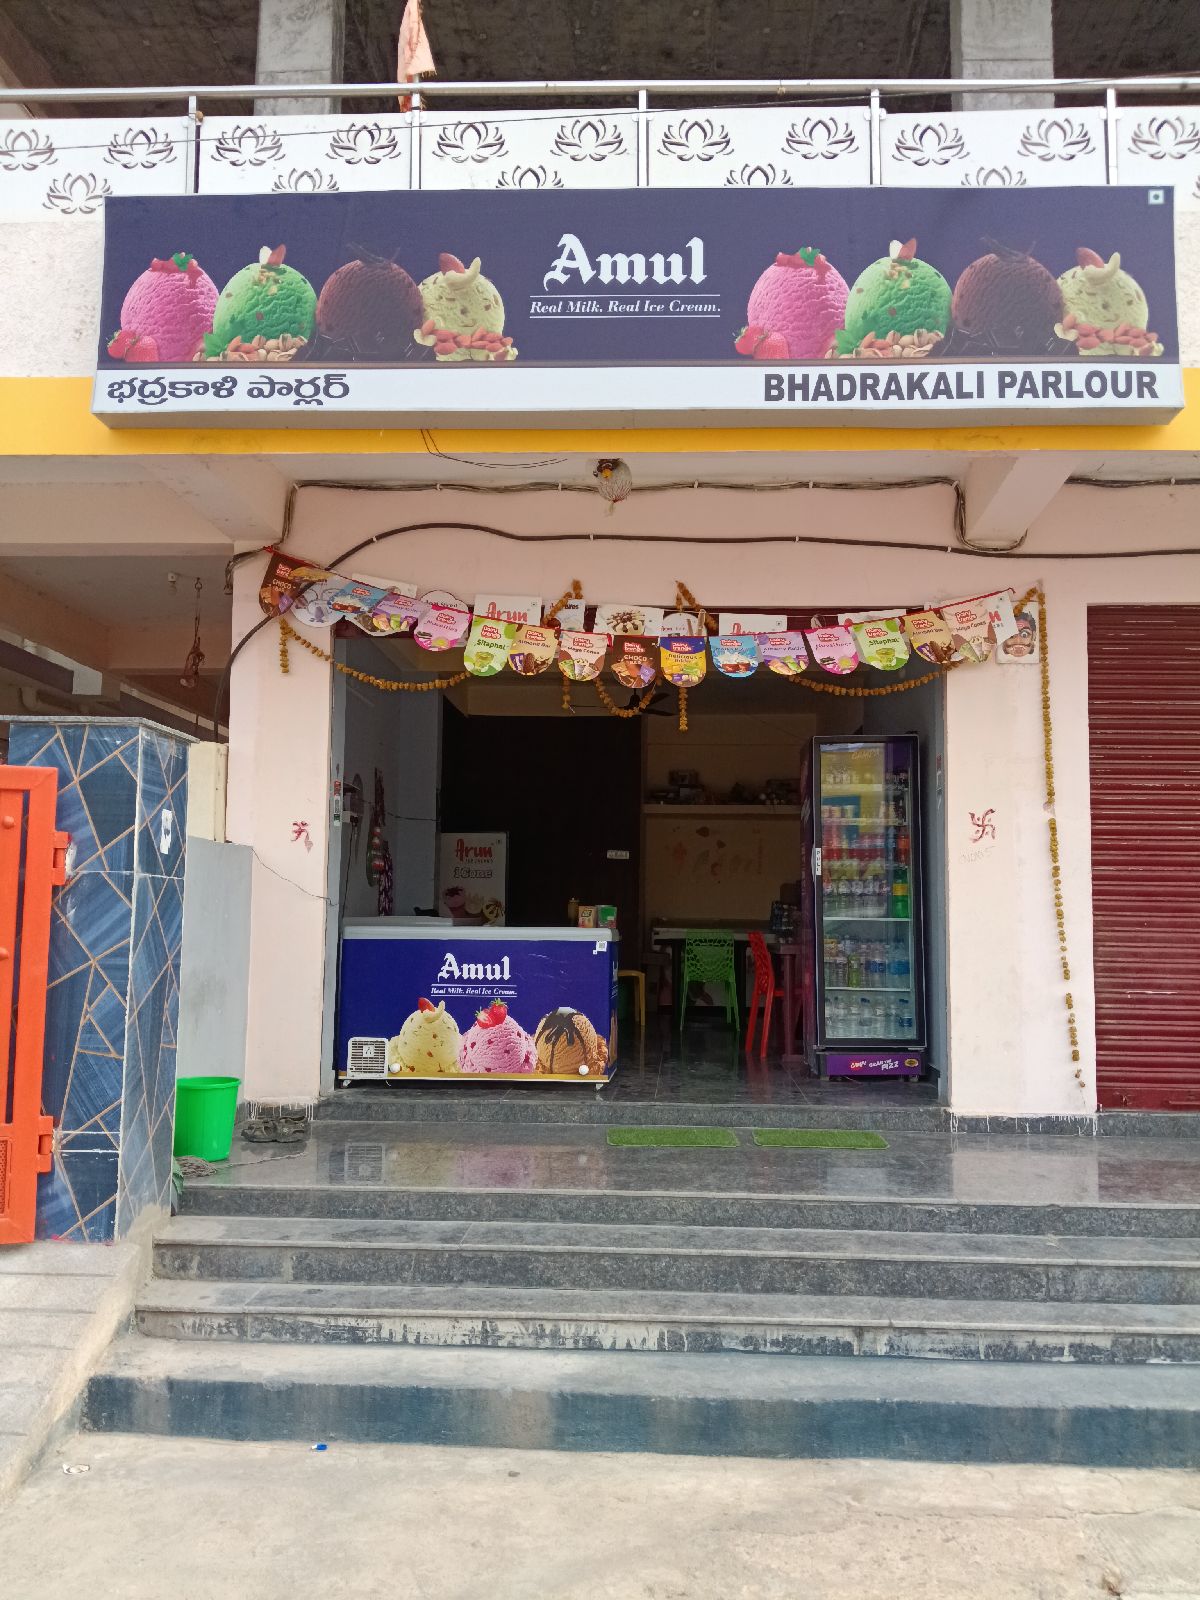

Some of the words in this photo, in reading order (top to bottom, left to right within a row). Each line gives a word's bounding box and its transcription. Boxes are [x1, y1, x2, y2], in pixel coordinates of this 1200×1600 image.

[543, 233, 707, 291] Amul
[530, 301, 562, 314] Real
[567, 301, 603, 313] Milk.
[607, 300, 640, 313] Real
[643, 300, 665, 312] Ice
[668, 299, 721, 312] Cream.
[107, 375, 238, 405] భద్రకాళి
[247, 374, 350, 405] పార్లర్
[764, 371, 984, 402] BHADRAKALI
[998, 370, 1158, 399] PARLOUR
[623, 654, 648, 662] CHOCO
[455, 838, 493, 862] Arun
[437, 952, 512, 982] Amul
[466, 987, 481, 995] Real
